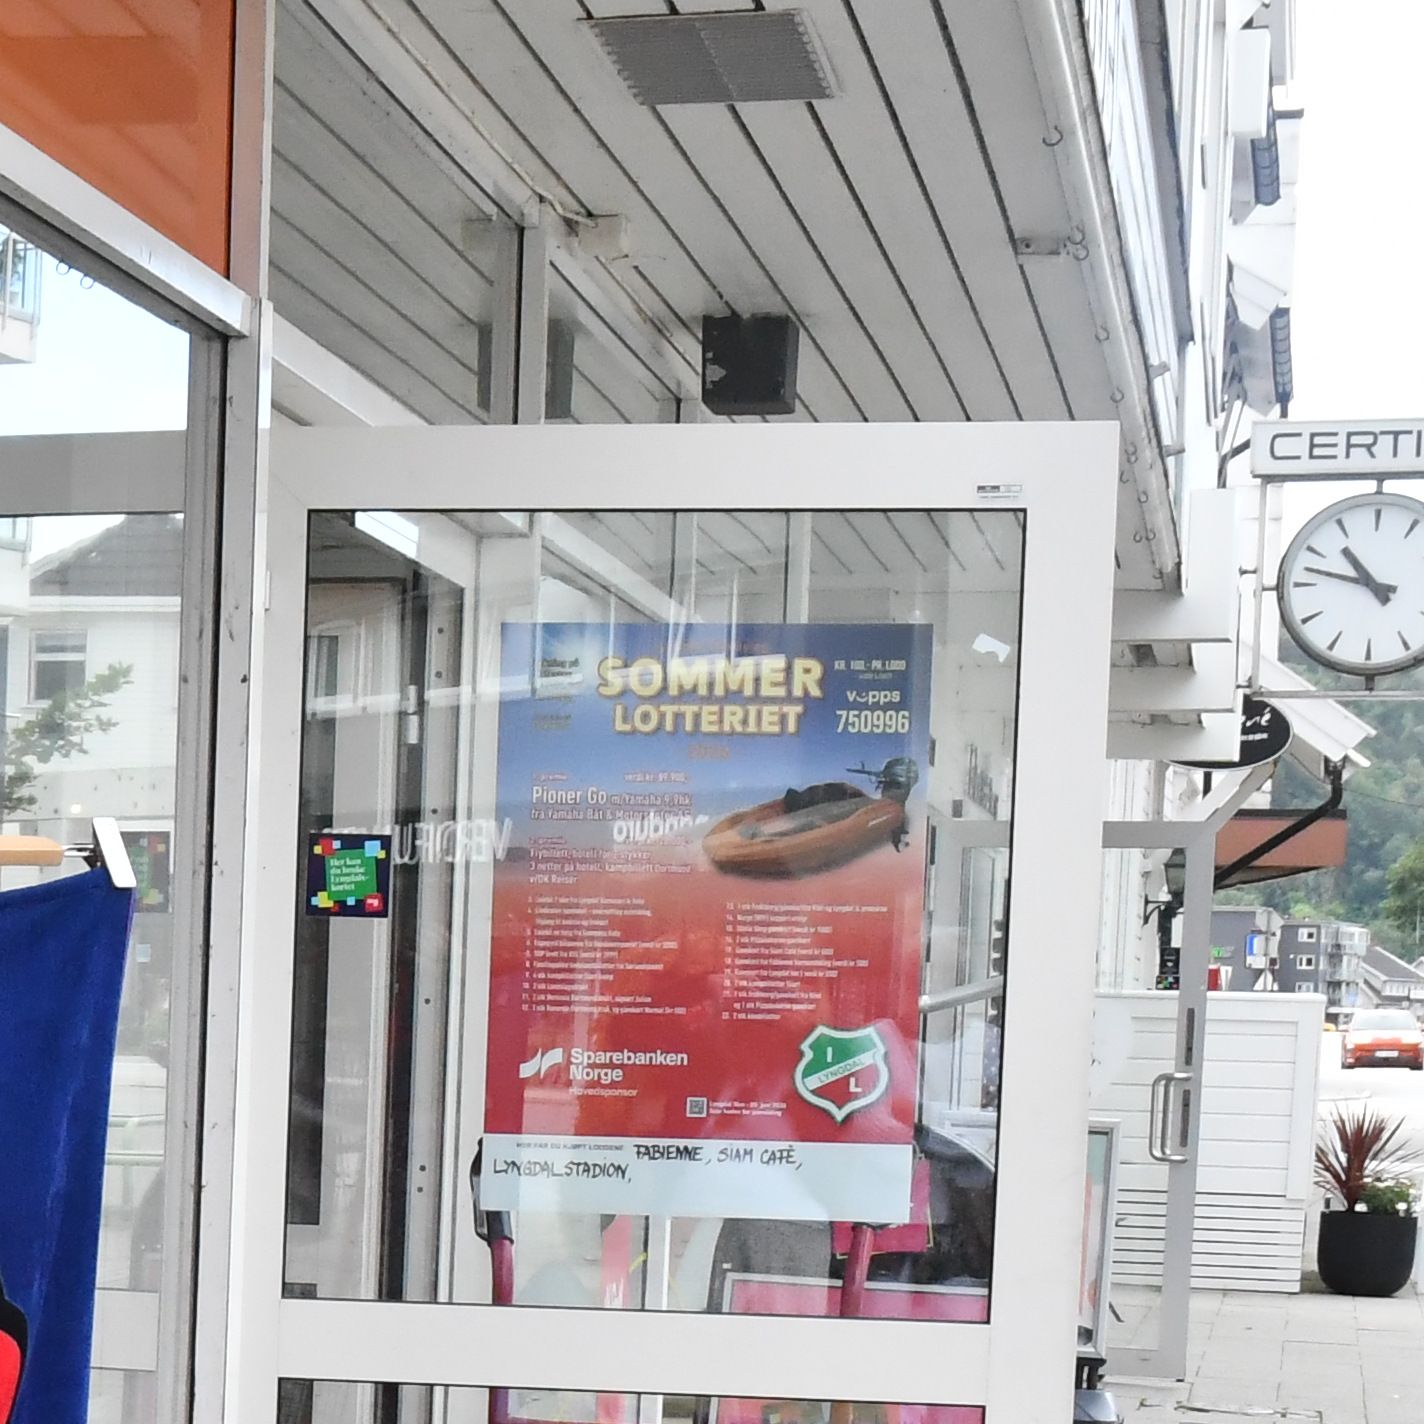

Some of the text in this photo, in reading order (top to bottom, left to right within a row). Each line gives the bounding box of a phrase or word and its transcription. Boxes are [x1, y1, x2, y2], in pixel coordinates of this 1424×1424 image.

[597, 657, 825, 698] SOMMER
[613, 703, 805, 735] LOTTERIET
[835, 710, 911, 734] 750996
[532, 786, 583, 804] Pioner
[587, 787, 608, 805] Go
[570, 1047, 689, 1066] Sparebanken
[569, 1066, 624, 1084] Norge
[816, 1057, 866, 1084] LYNGDAL
[717, 1144, 754, 1163] SIAM
